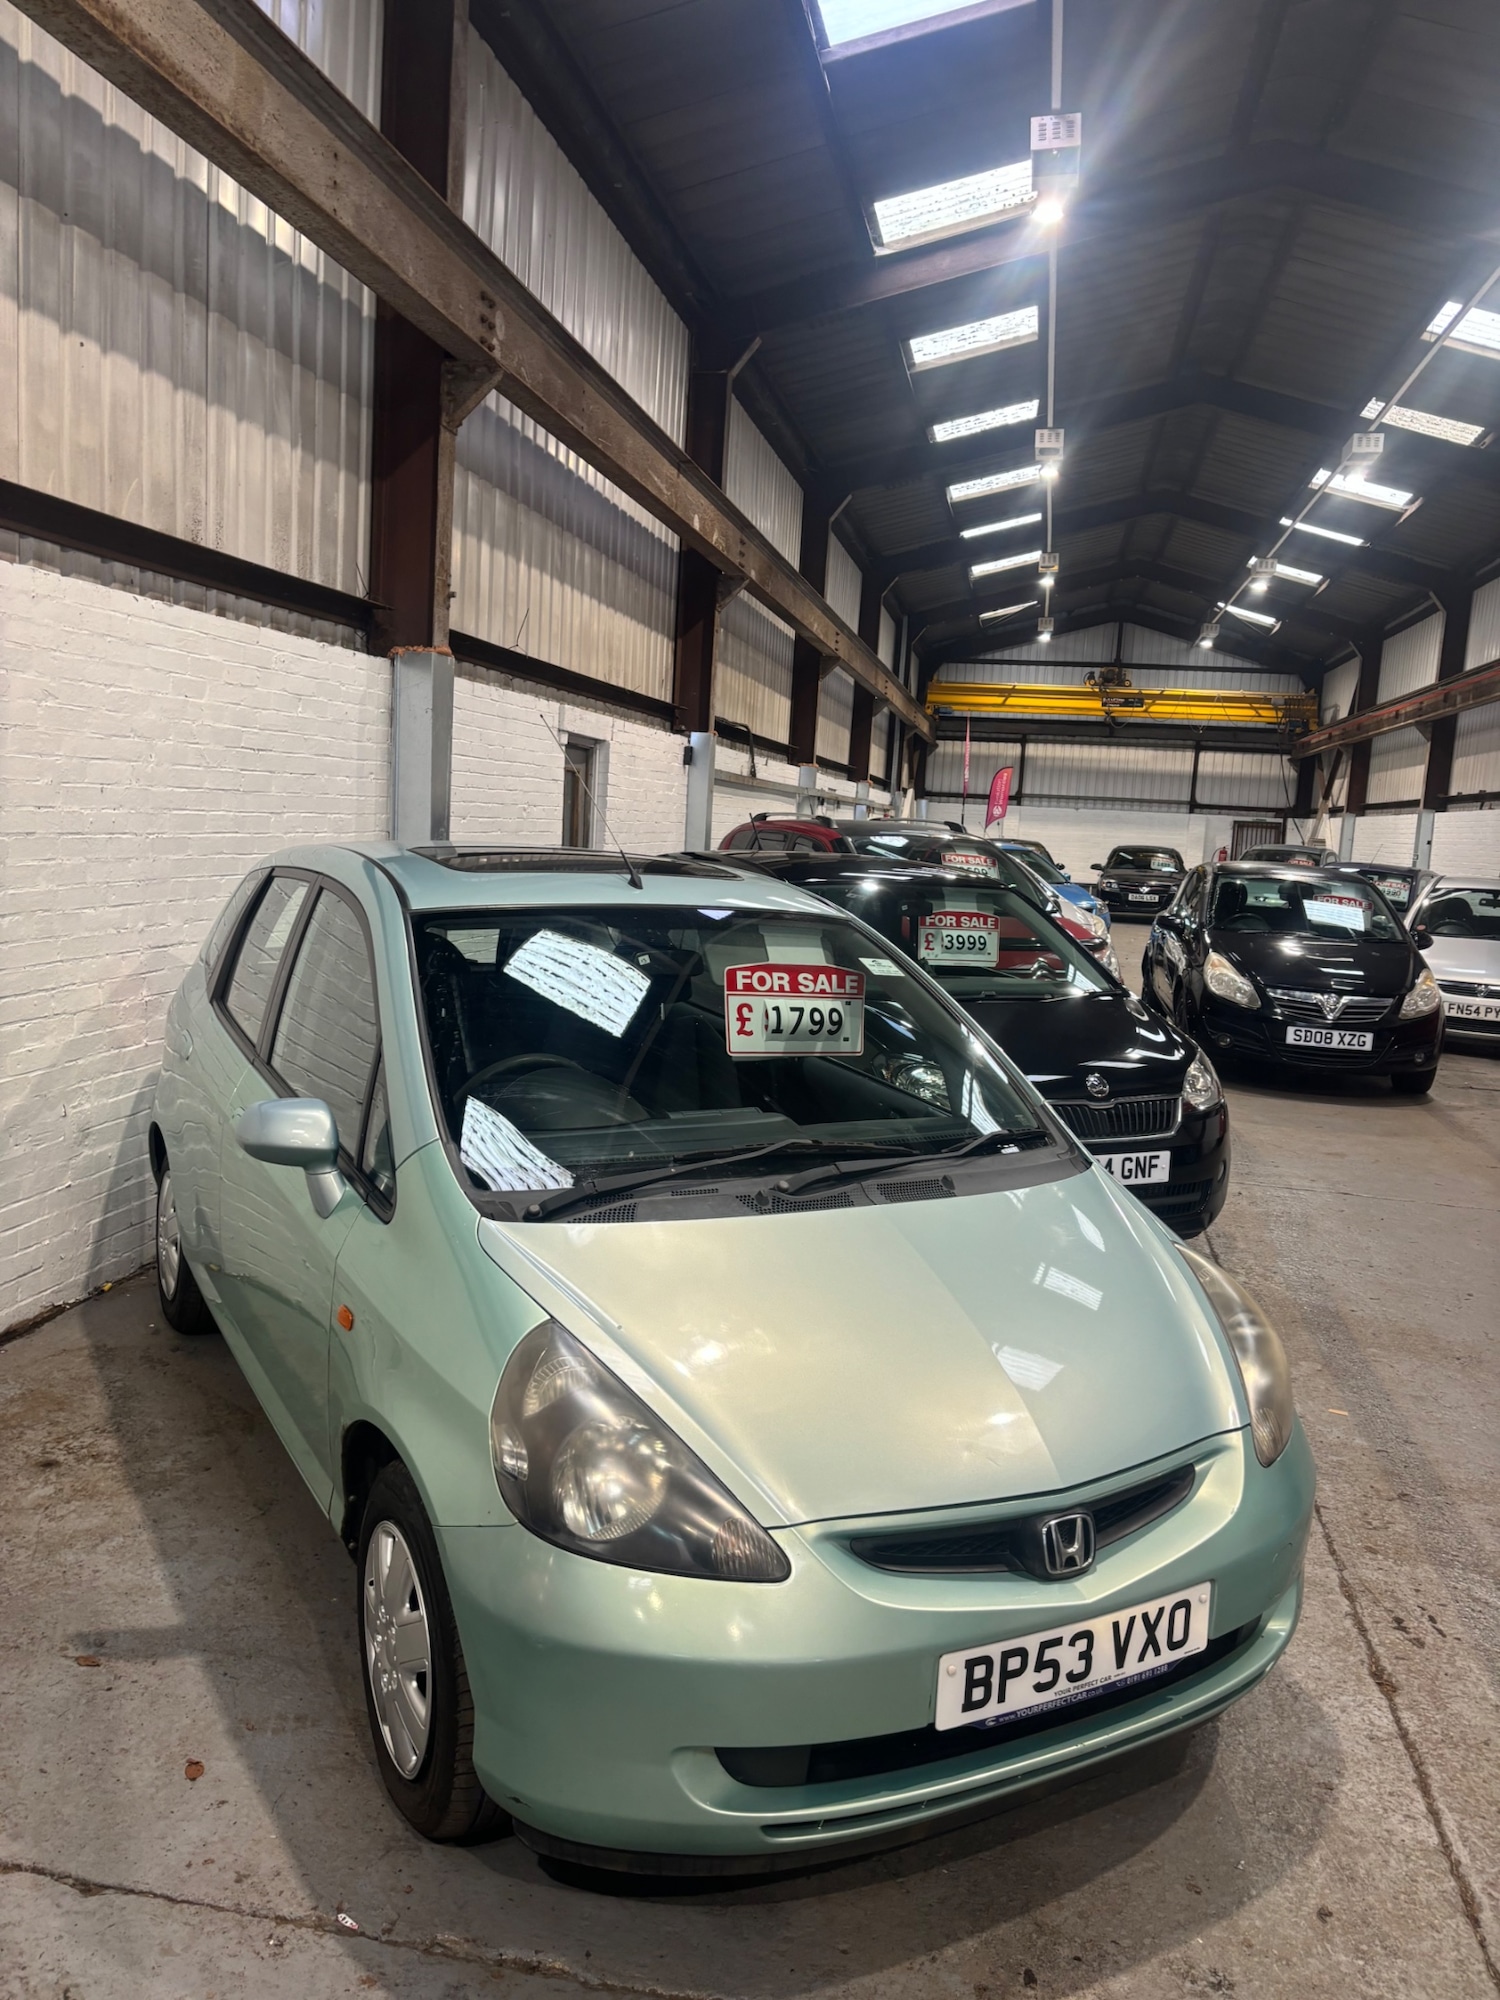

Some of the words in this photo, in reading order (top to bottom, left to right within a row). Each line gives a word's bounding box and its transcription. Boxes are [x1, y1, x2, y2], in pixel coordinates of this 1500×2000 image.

[945, 854, 966, 863] FOR
[968, 856, 993, 866] SALE
[1317, 896, 1338, 904] FOR
[1342, 899, 1369, 908] SALE
[926, 914, 956, 927] FOR
[960, 916, 995, 929] SALE
[924, 933, 935, 951] £
[944, 934, 987, 951] 3999
[736, 970, 790, 992] FOR
[798, 973, 859, 994] SALE
[1448, 1003, 1481, 1017] FN54
[736, 1003, 754, 1037] £
[771, 1005, 843, 1036] 1799
[1293, 1029, 1333, 1045] SD08
[1337, 1032, 1367, 1047] XZG
[1121, 1154, 1160, 1180] GNF
[961, 1629, 1094, 1713] BP53
[1112, 1599, 1191, 1670] VXO
[1054, 1687, 1071, 1697] YOUR
[1072, 1679, 1099, 1692] PERFECT
[1100, 1675, 1112, 1684] CAR
